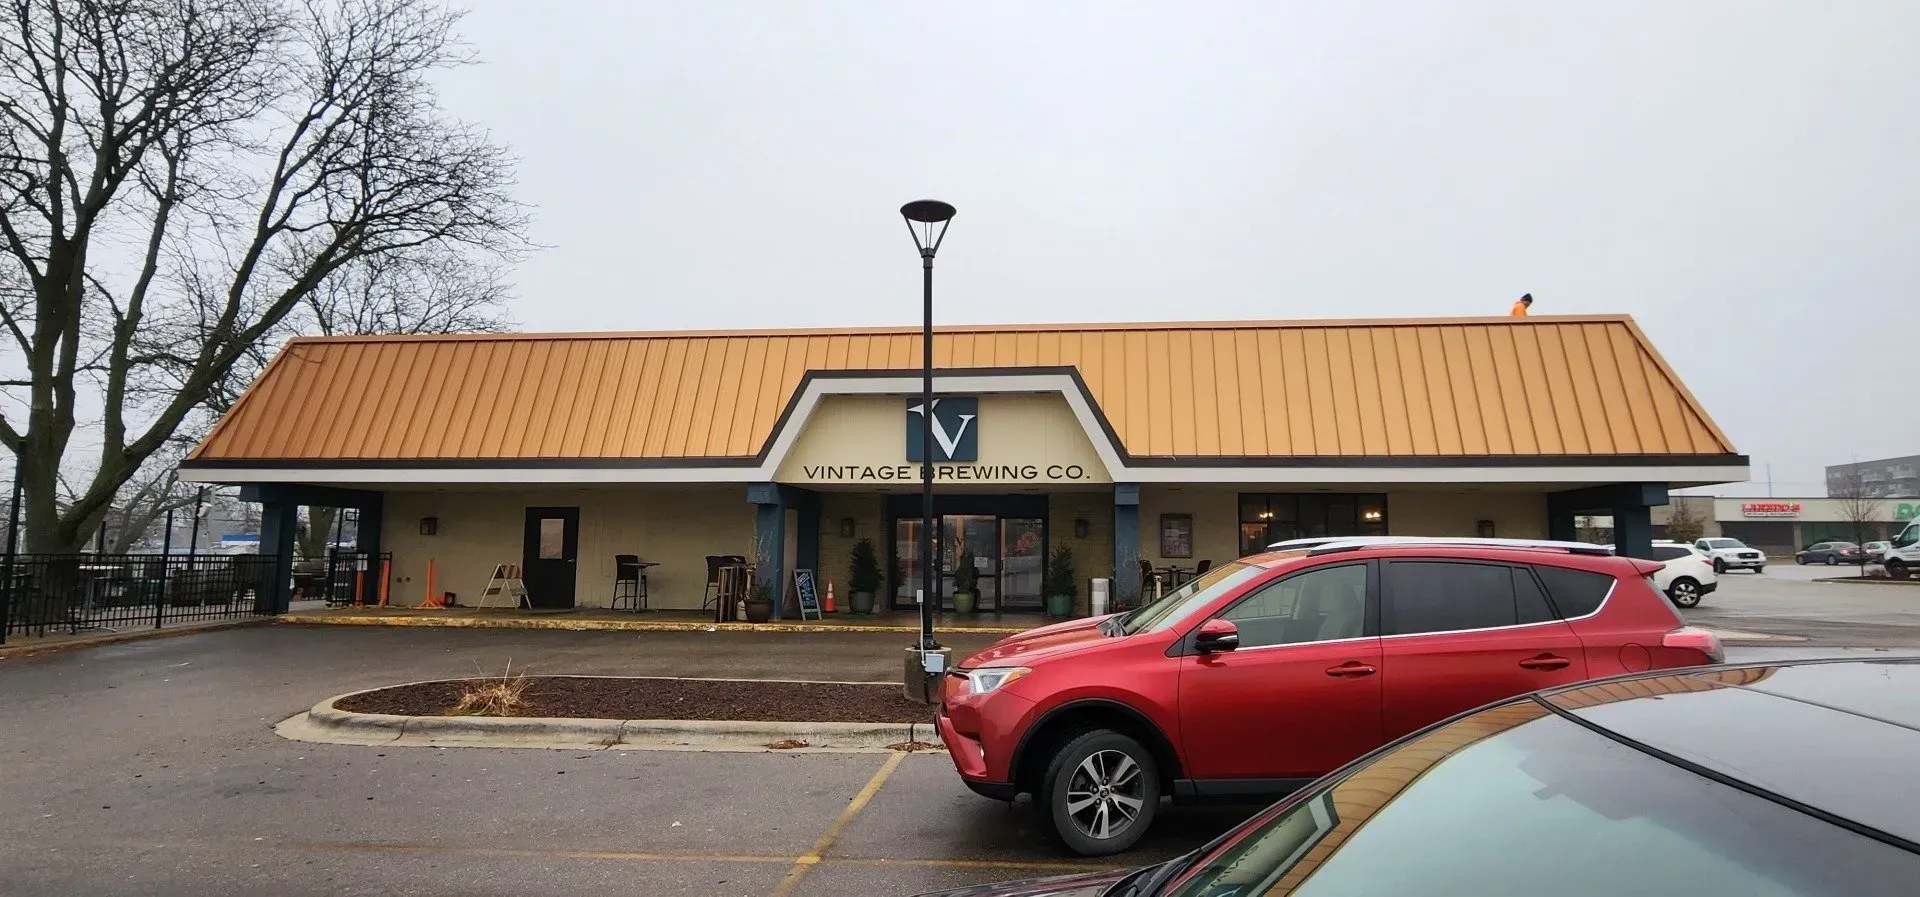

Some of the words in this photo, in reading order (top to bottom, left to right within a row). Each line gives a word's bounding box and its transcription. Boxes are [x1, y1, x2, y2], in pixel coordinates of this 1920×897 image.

[803, 465, 912, 480] VINTAGE
[919, 465, 1038, 480] BREWING
[1046, 465, 1091, 480] CO.
